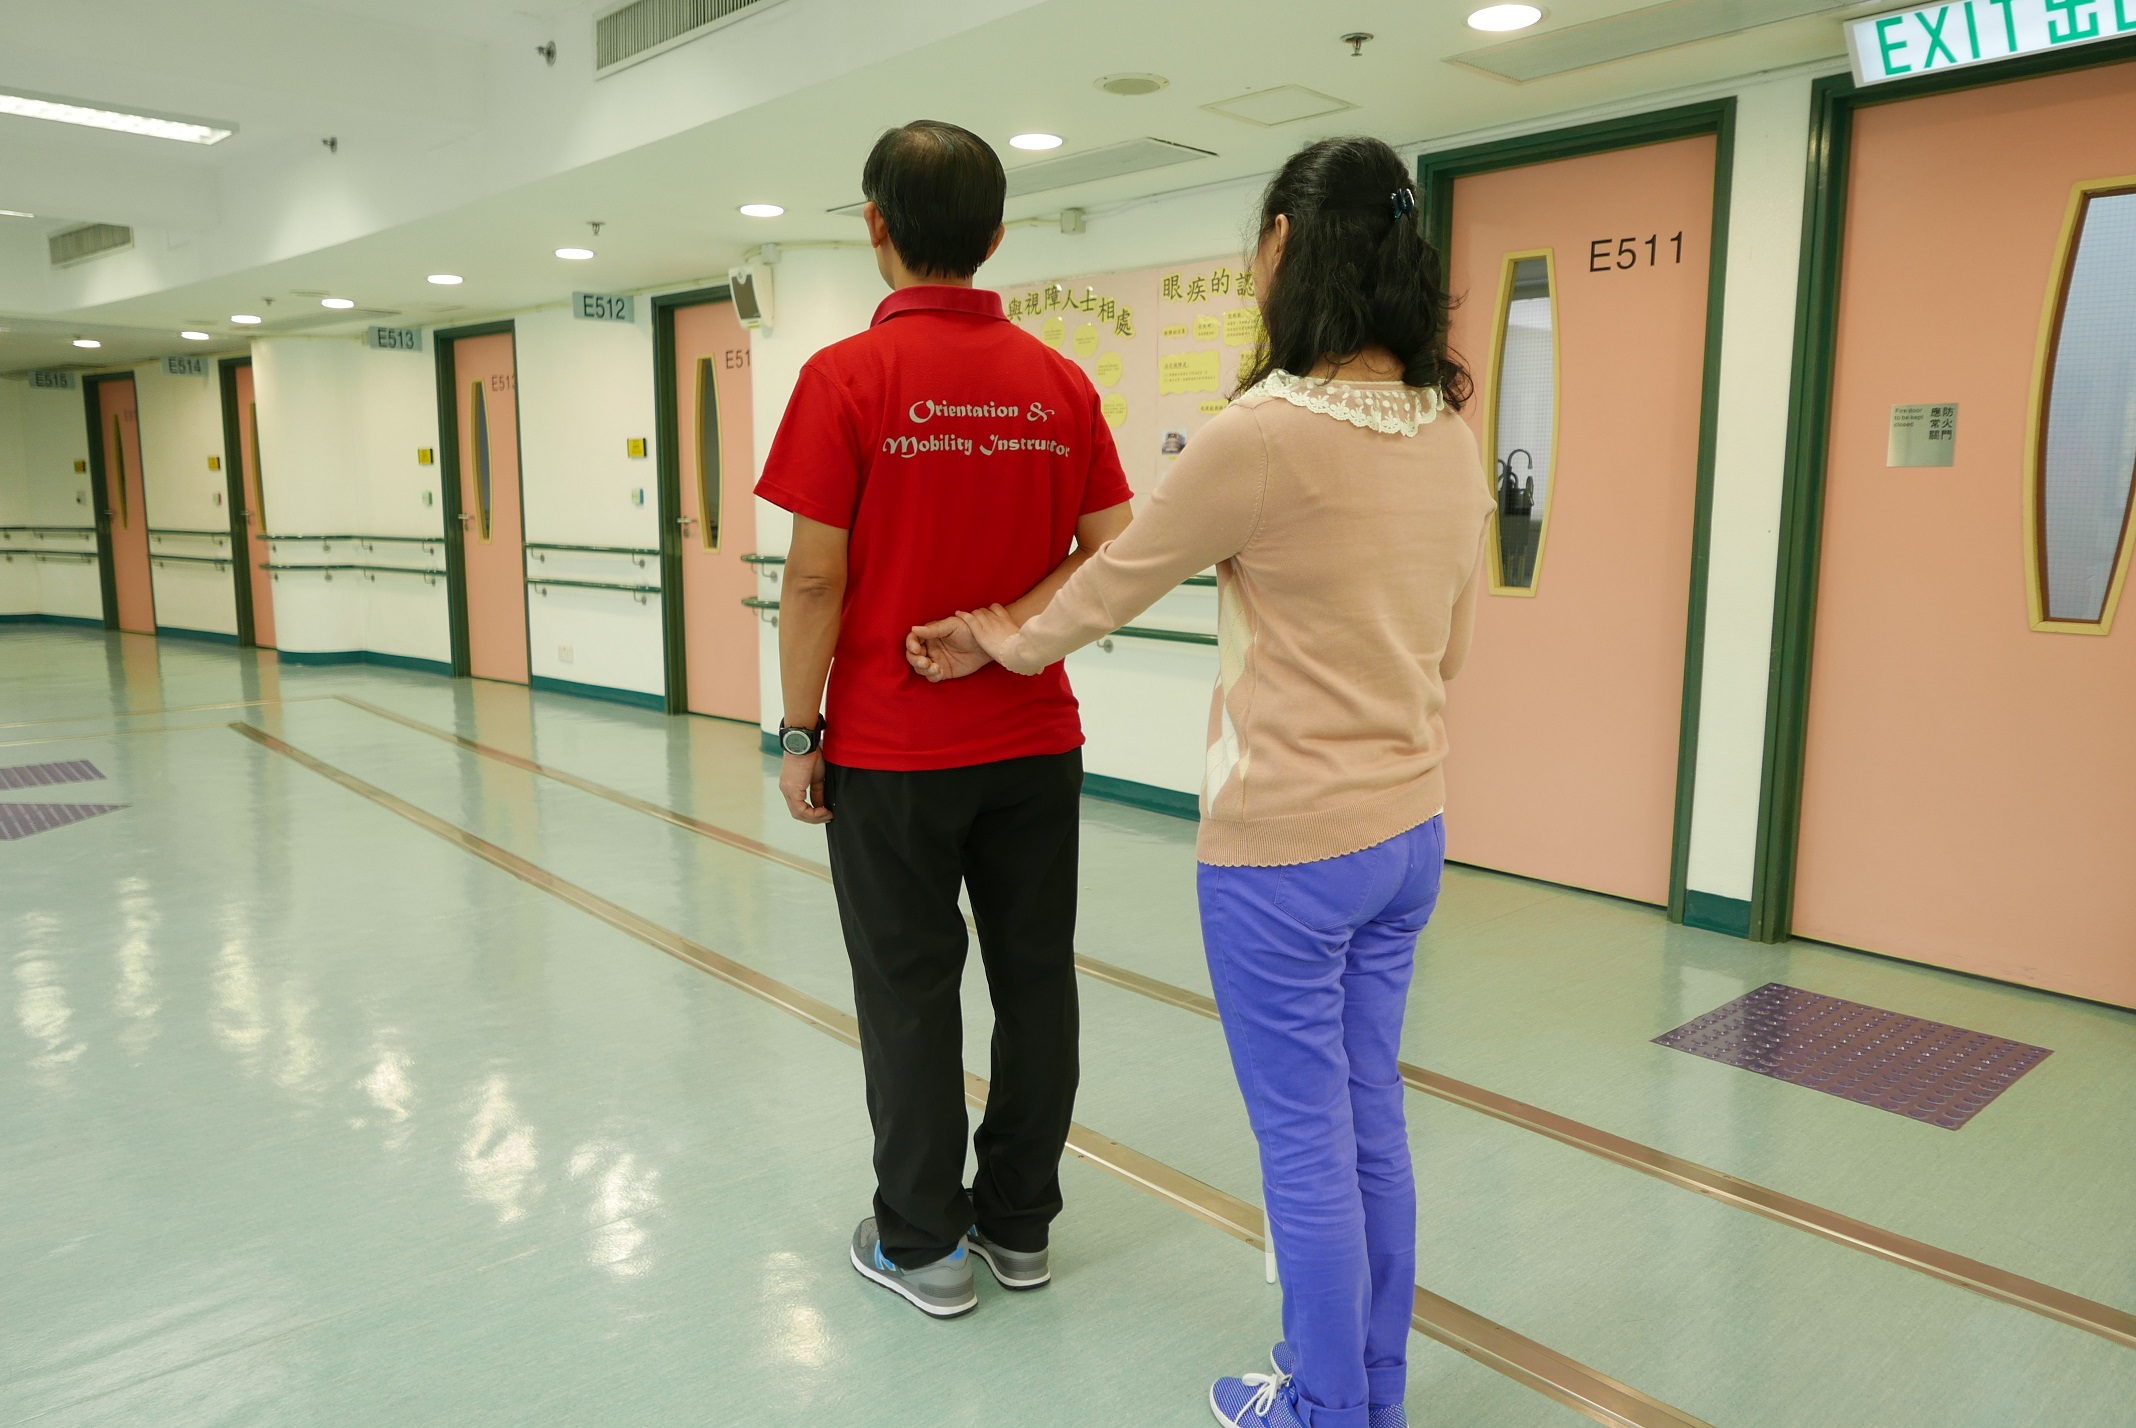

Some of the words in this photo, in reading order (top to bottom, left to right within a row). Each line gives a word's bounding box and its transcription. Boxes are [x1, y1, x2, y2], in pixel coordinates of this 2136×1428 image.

[1875, 0, 2018, 76] EXIT
[1590, 231, 1683, 272] E511
[583, 295, 626, 320] E512
[1007, 284, 1132, 336] 與視障人士相處
[377, 328, 415, 350] E513
[168, 356, 202, 375] E514
[491, 375, 515, 392] E51
[909, 400, 1019, 423] Orientation
[1026, 402, 1055, 422] &
[1941, 407, 1954, 440] 防火門
[882, 435, 973, 458] Mobility
